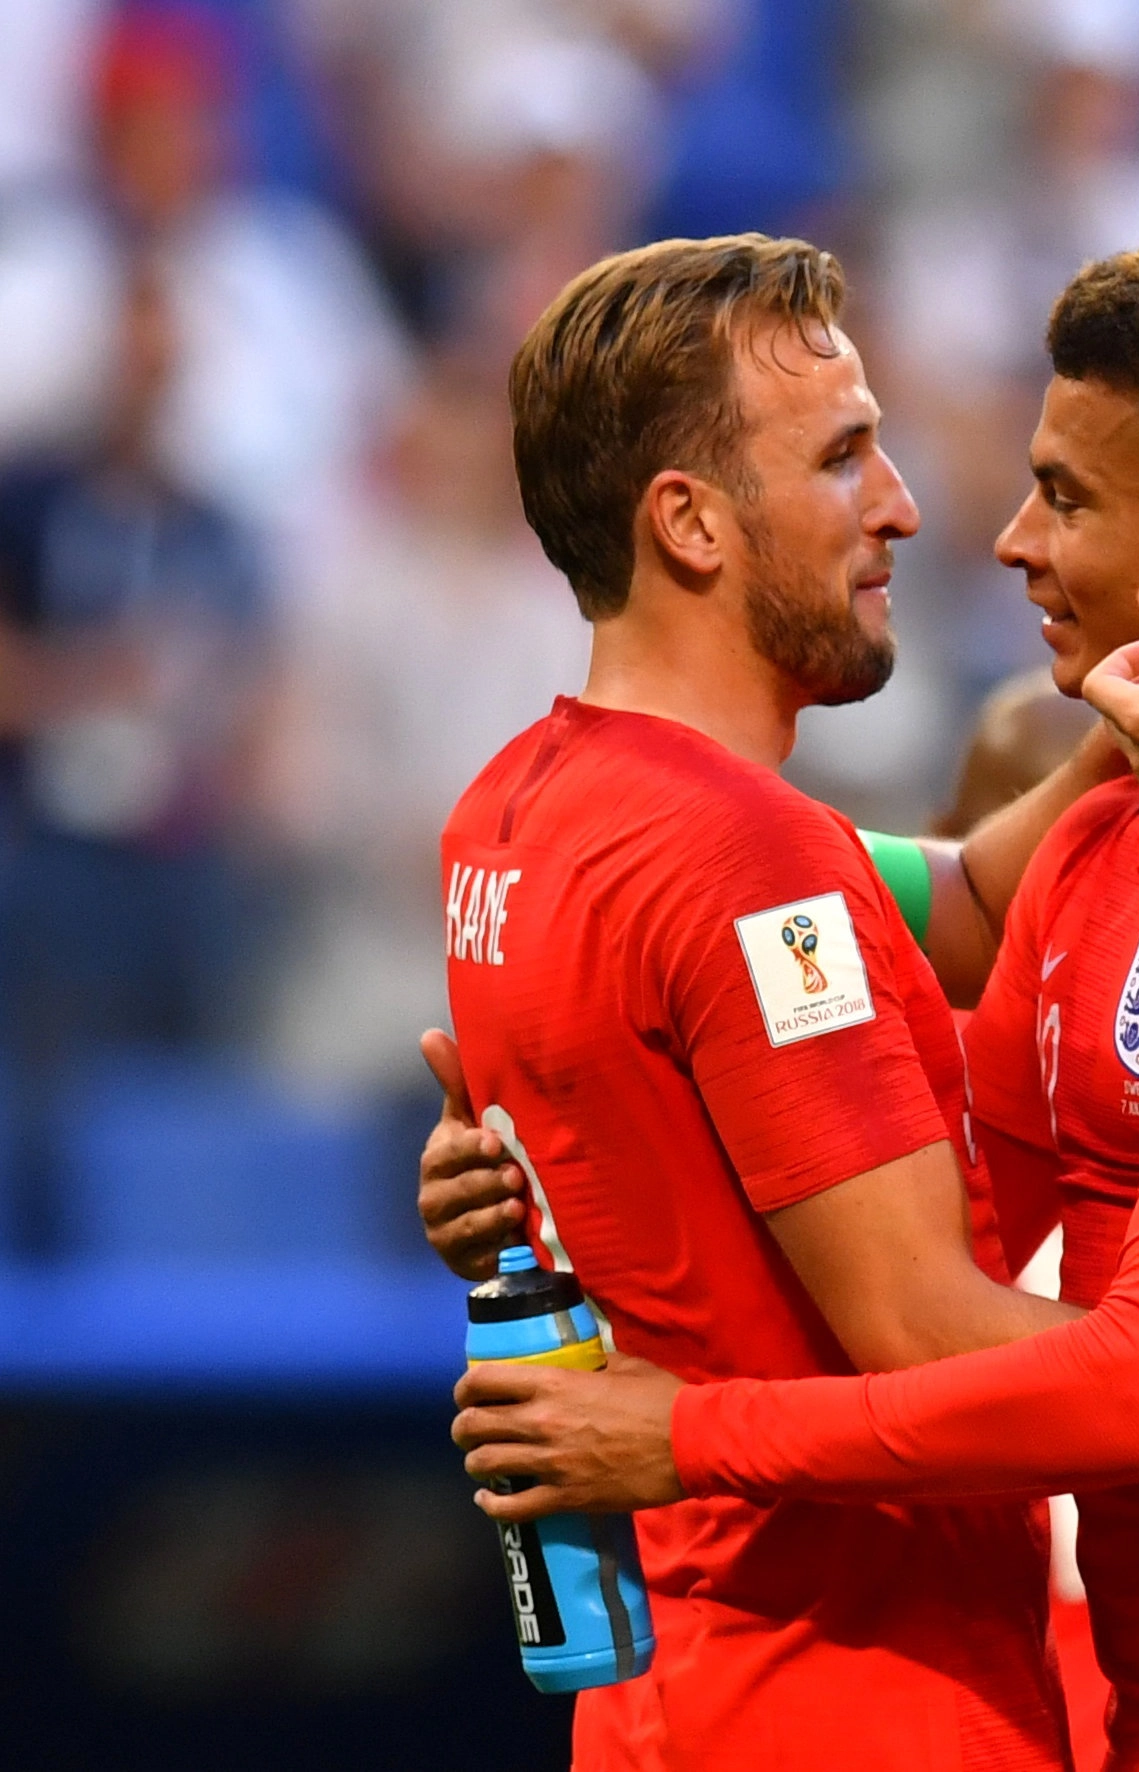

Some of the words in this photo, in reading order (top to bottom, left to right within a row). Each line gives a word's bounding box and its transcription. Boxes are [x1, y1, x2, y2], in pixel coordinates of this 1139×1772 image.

[446, 861, 522, 966] KANE
[775, 1008, 834, 1034] RUSSIA
[835, 998, 866, 1017] 2018
[1121, 1099, 1127, 1115] 7
[503, 1519, 541, 1643] RADE
